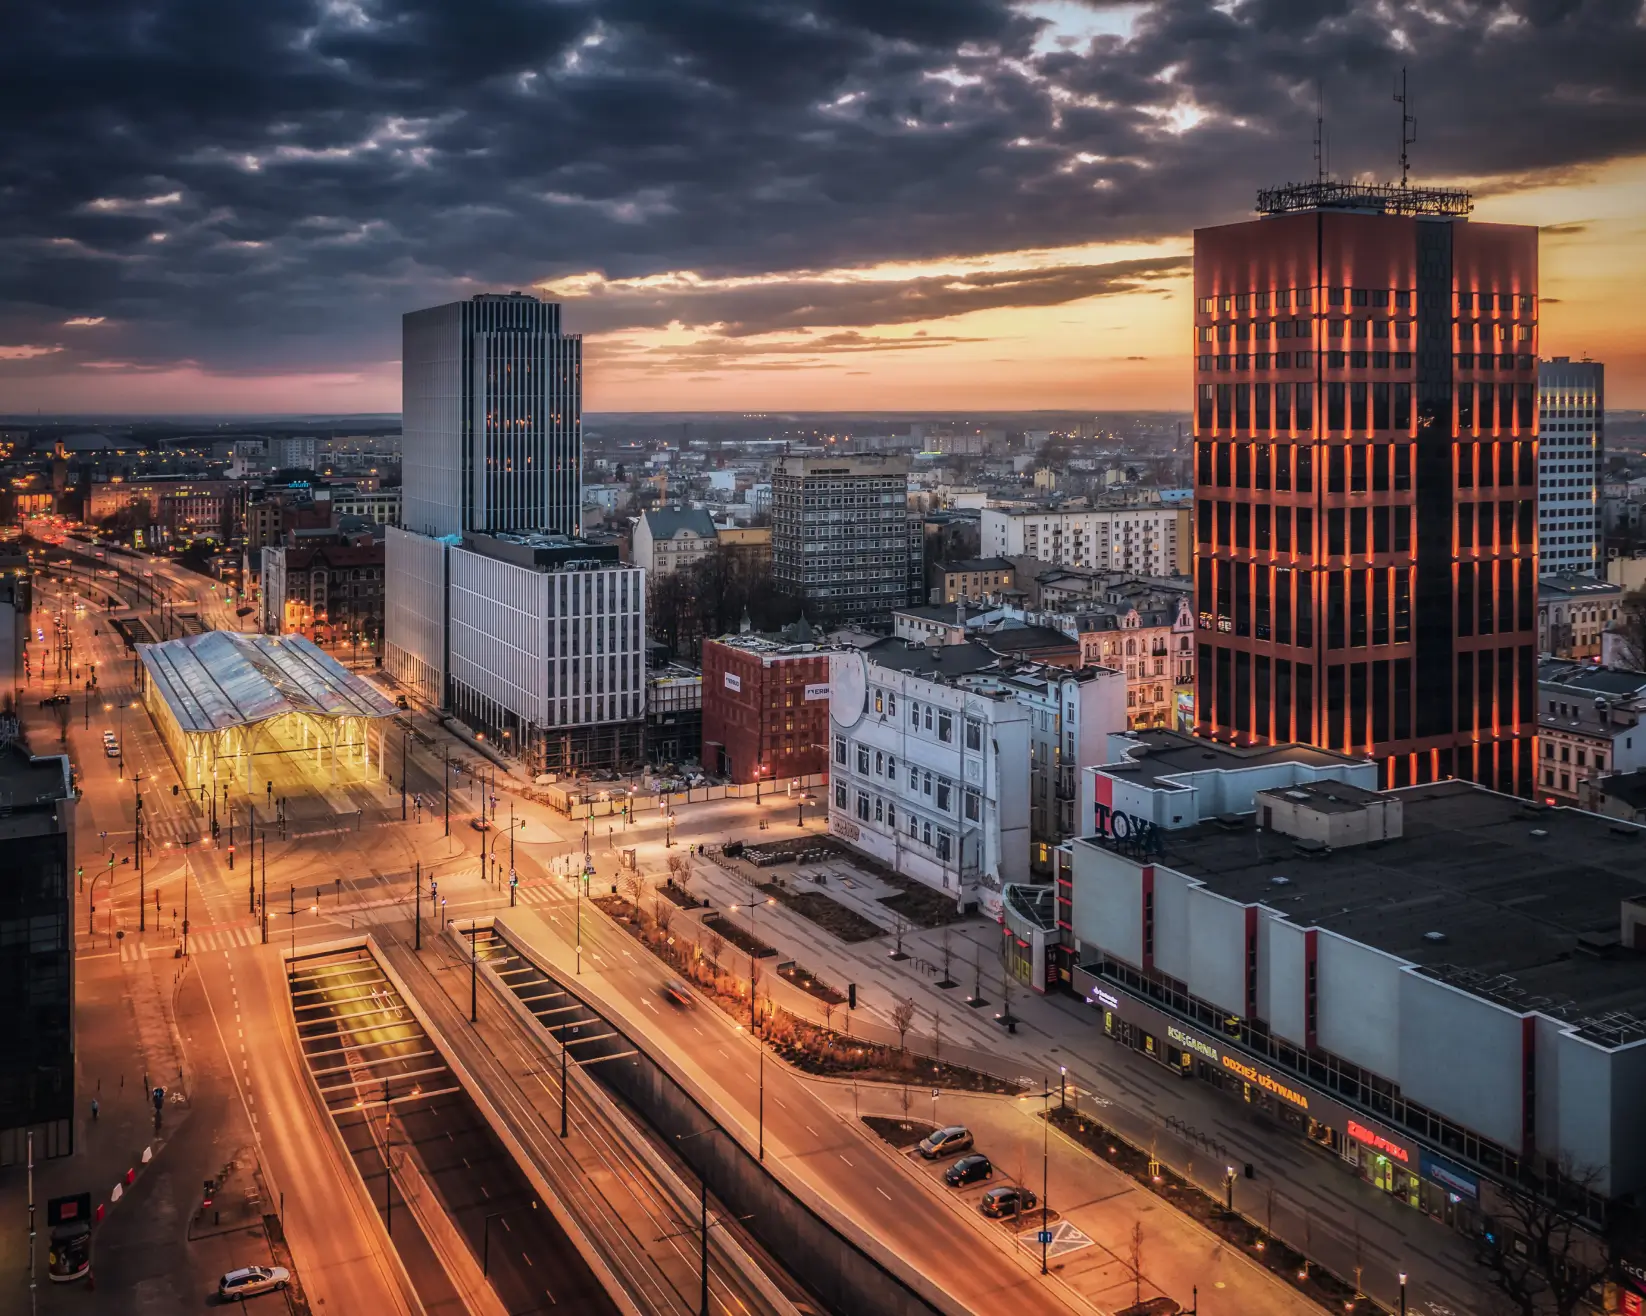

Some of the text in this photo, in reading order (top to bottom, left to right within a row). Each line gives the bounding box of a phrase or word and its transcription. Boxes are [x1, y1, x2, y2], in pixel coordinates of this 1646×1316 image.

[1095, 801, 1163, 853] TOYA
[1167, 1025, 1218, 1060] KSIĘGARNIA
[1222, 1055, 1258, 1082] ODZIEŻ
[1258, 1075, 1308, 1109] UŻYWANA
